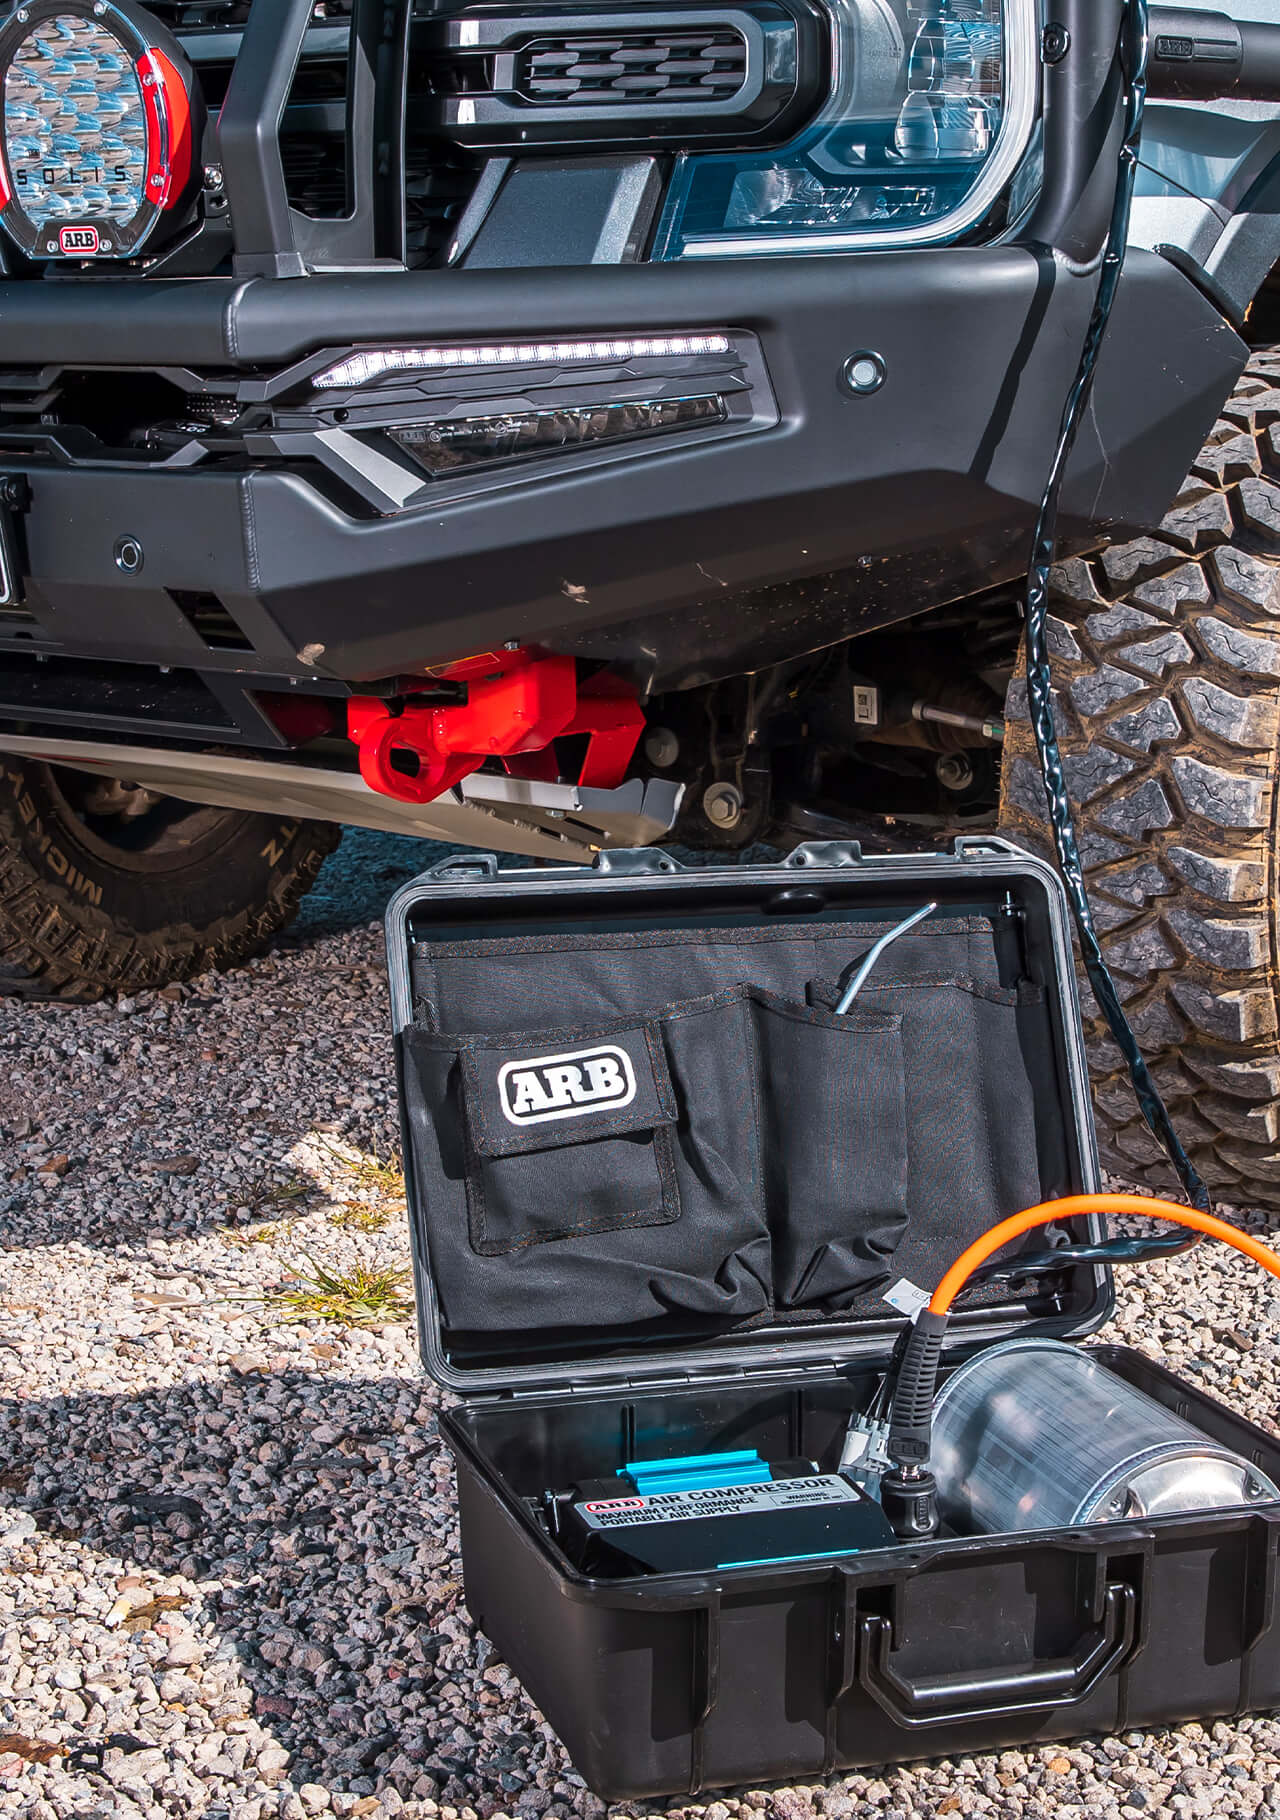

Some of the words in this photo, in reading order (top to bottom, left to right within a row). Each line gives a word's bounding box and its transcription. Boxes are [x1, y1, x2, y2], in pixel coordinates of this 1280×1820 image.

[17, 165, 127, 185] SOLIS
[64, 232, 95, 248] ARB
[512, 1057, 625, 1115] ARB
[595, 1501, 637, 1511] ARB
[648, 1495, 682, 1506] AIR
[687, 1478, 835, 1501] COMPRESSOR
[595, 1507, 660, 1521] MAXIMUM
[661, 1496, 759, 1514] PERFORMANCE
[599, 1514, 665, 1527] PORTABLE
[669, 1511, 691, 1519] AIR
[695, 1505, 741, 1517] SUPPLY
